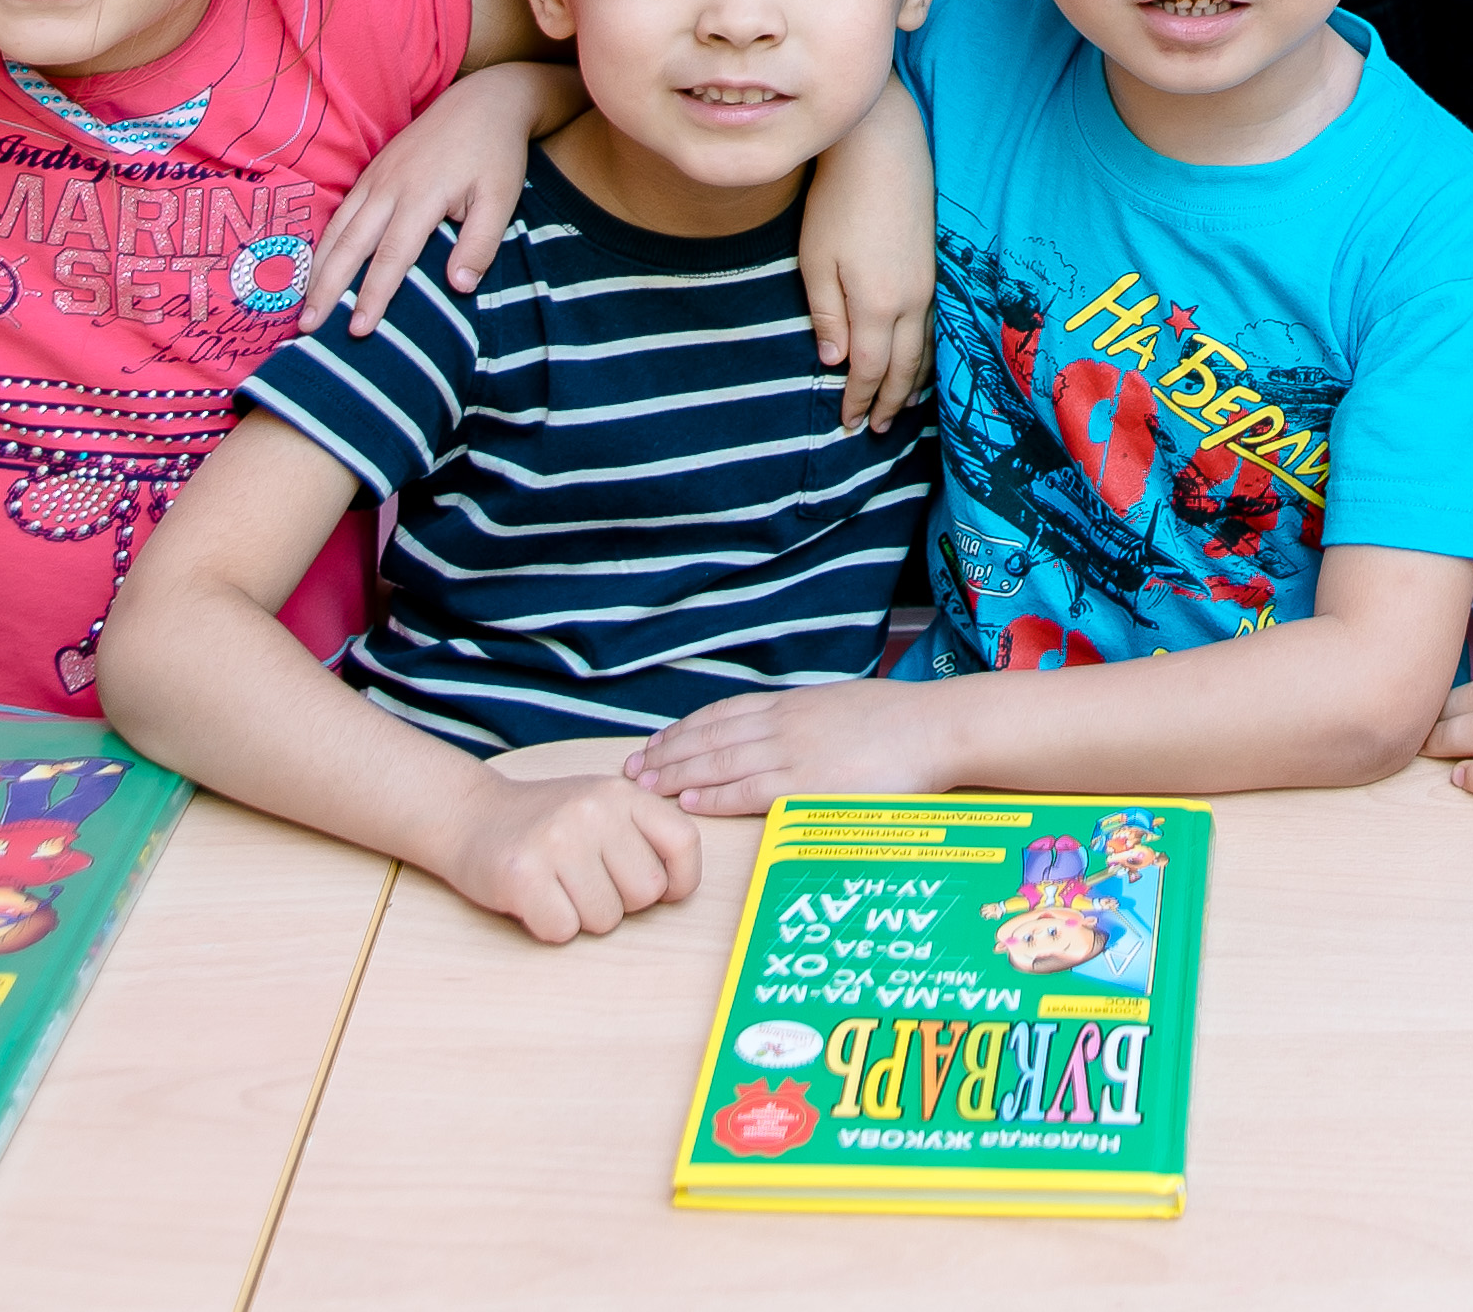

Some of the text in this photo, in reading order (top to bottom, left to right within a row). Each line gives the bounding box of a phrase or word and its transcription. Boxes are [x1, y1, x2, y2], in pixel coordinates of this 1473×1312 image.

[52, 247, 228, 325] SET
[807, 811, 1020, 823] ЛОГОПЕДИЧЕСКОЙ МЕТОДИКИ
[802, 828, 930, 839] И ОРИГИНАЛЬНОЙ
[798, 847, 995, 859] СОЧЕТАНИЕ ТРАДИЦИОННОЙ
[843, 879, 942, 896] ЛУ-НА
[778, 893, 937, 933] АМ АУ
[780, 923, 932, 959] РО-ЗА СА
[763, 952, 977, 985] МЫ-ЛО УС ОХ
[755, 985, 1022, 1011] МА-МА РА-МА
[825, 1018, 1152, 1124] БУКВАРЬ
[838, 1127, 1121, 1154] Надежда ЖУКОВА
